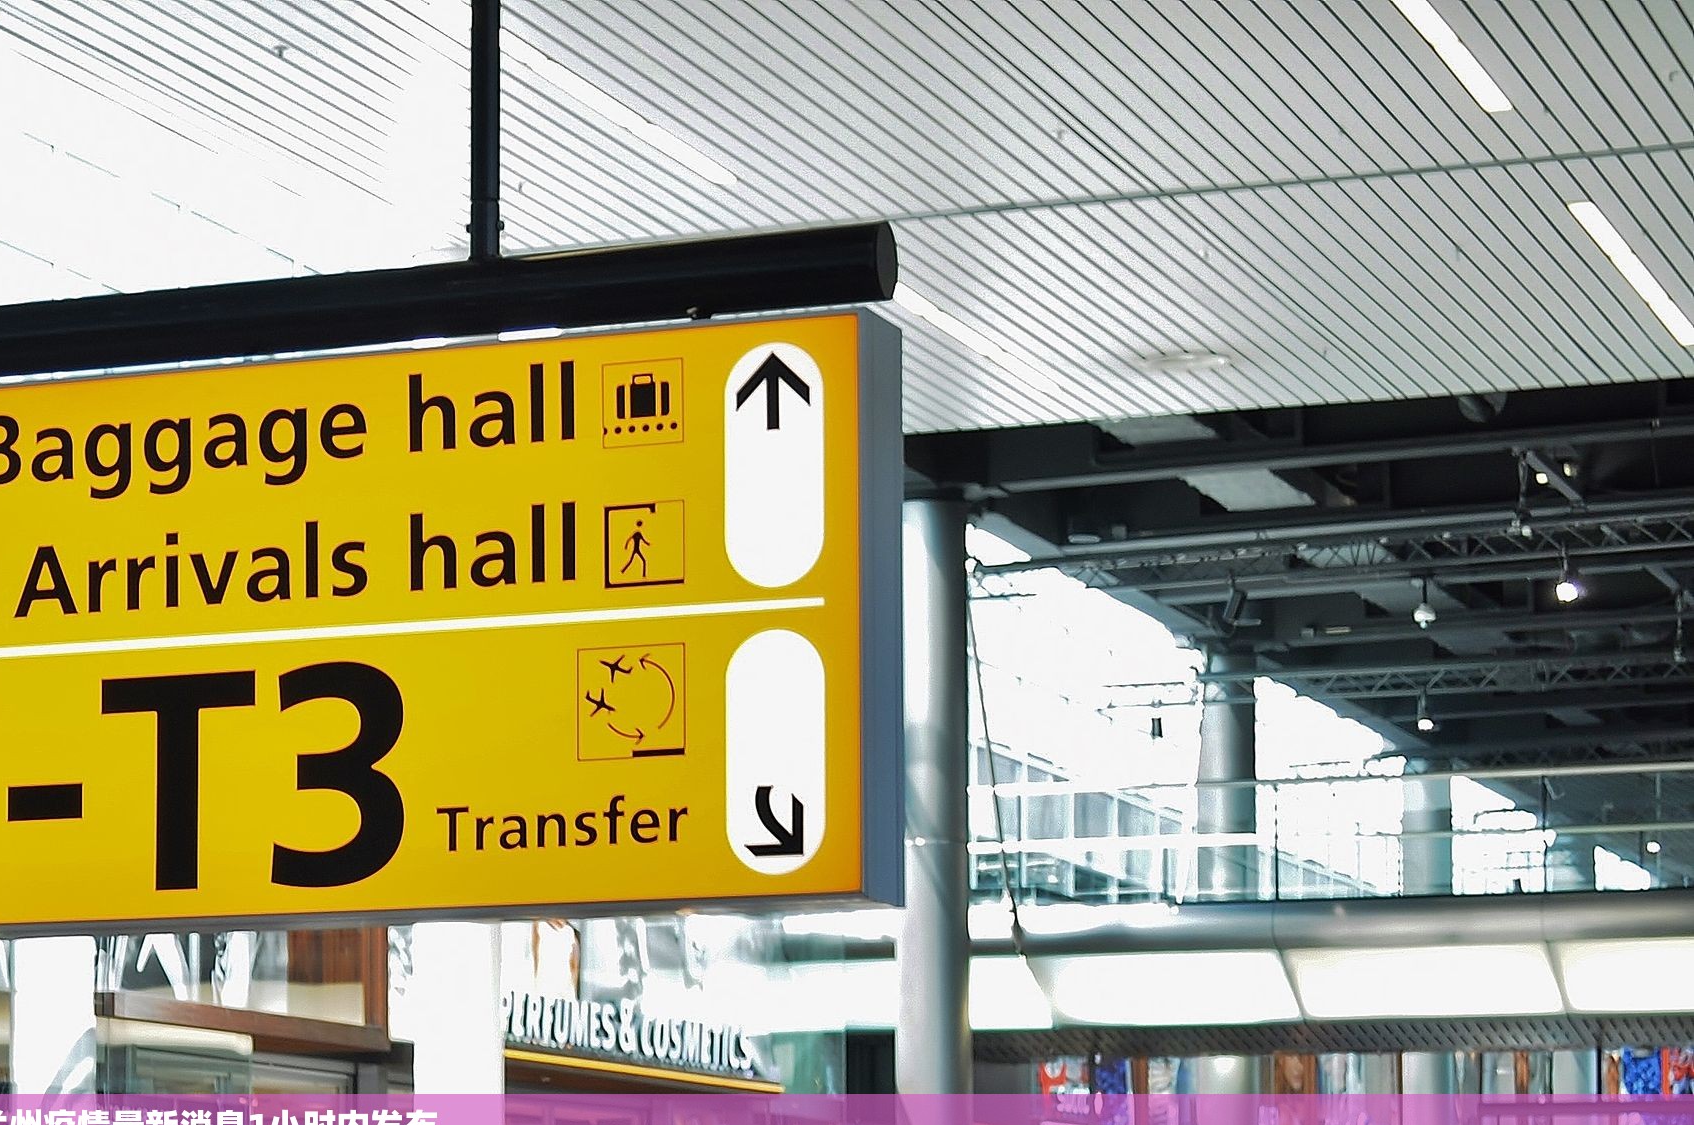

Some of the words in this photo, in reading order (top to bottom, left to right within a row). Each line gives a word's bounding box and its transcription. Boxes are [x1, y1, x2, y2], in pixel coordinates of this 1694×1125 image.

[407, 359, 576, 454] hall
[13, 520, 369, 619] Arrivals
[408, 500, 577, 593] hall
[435, 794, 689, 853] Transfer
[640, 1016, 755, 1071] COSMETICS
